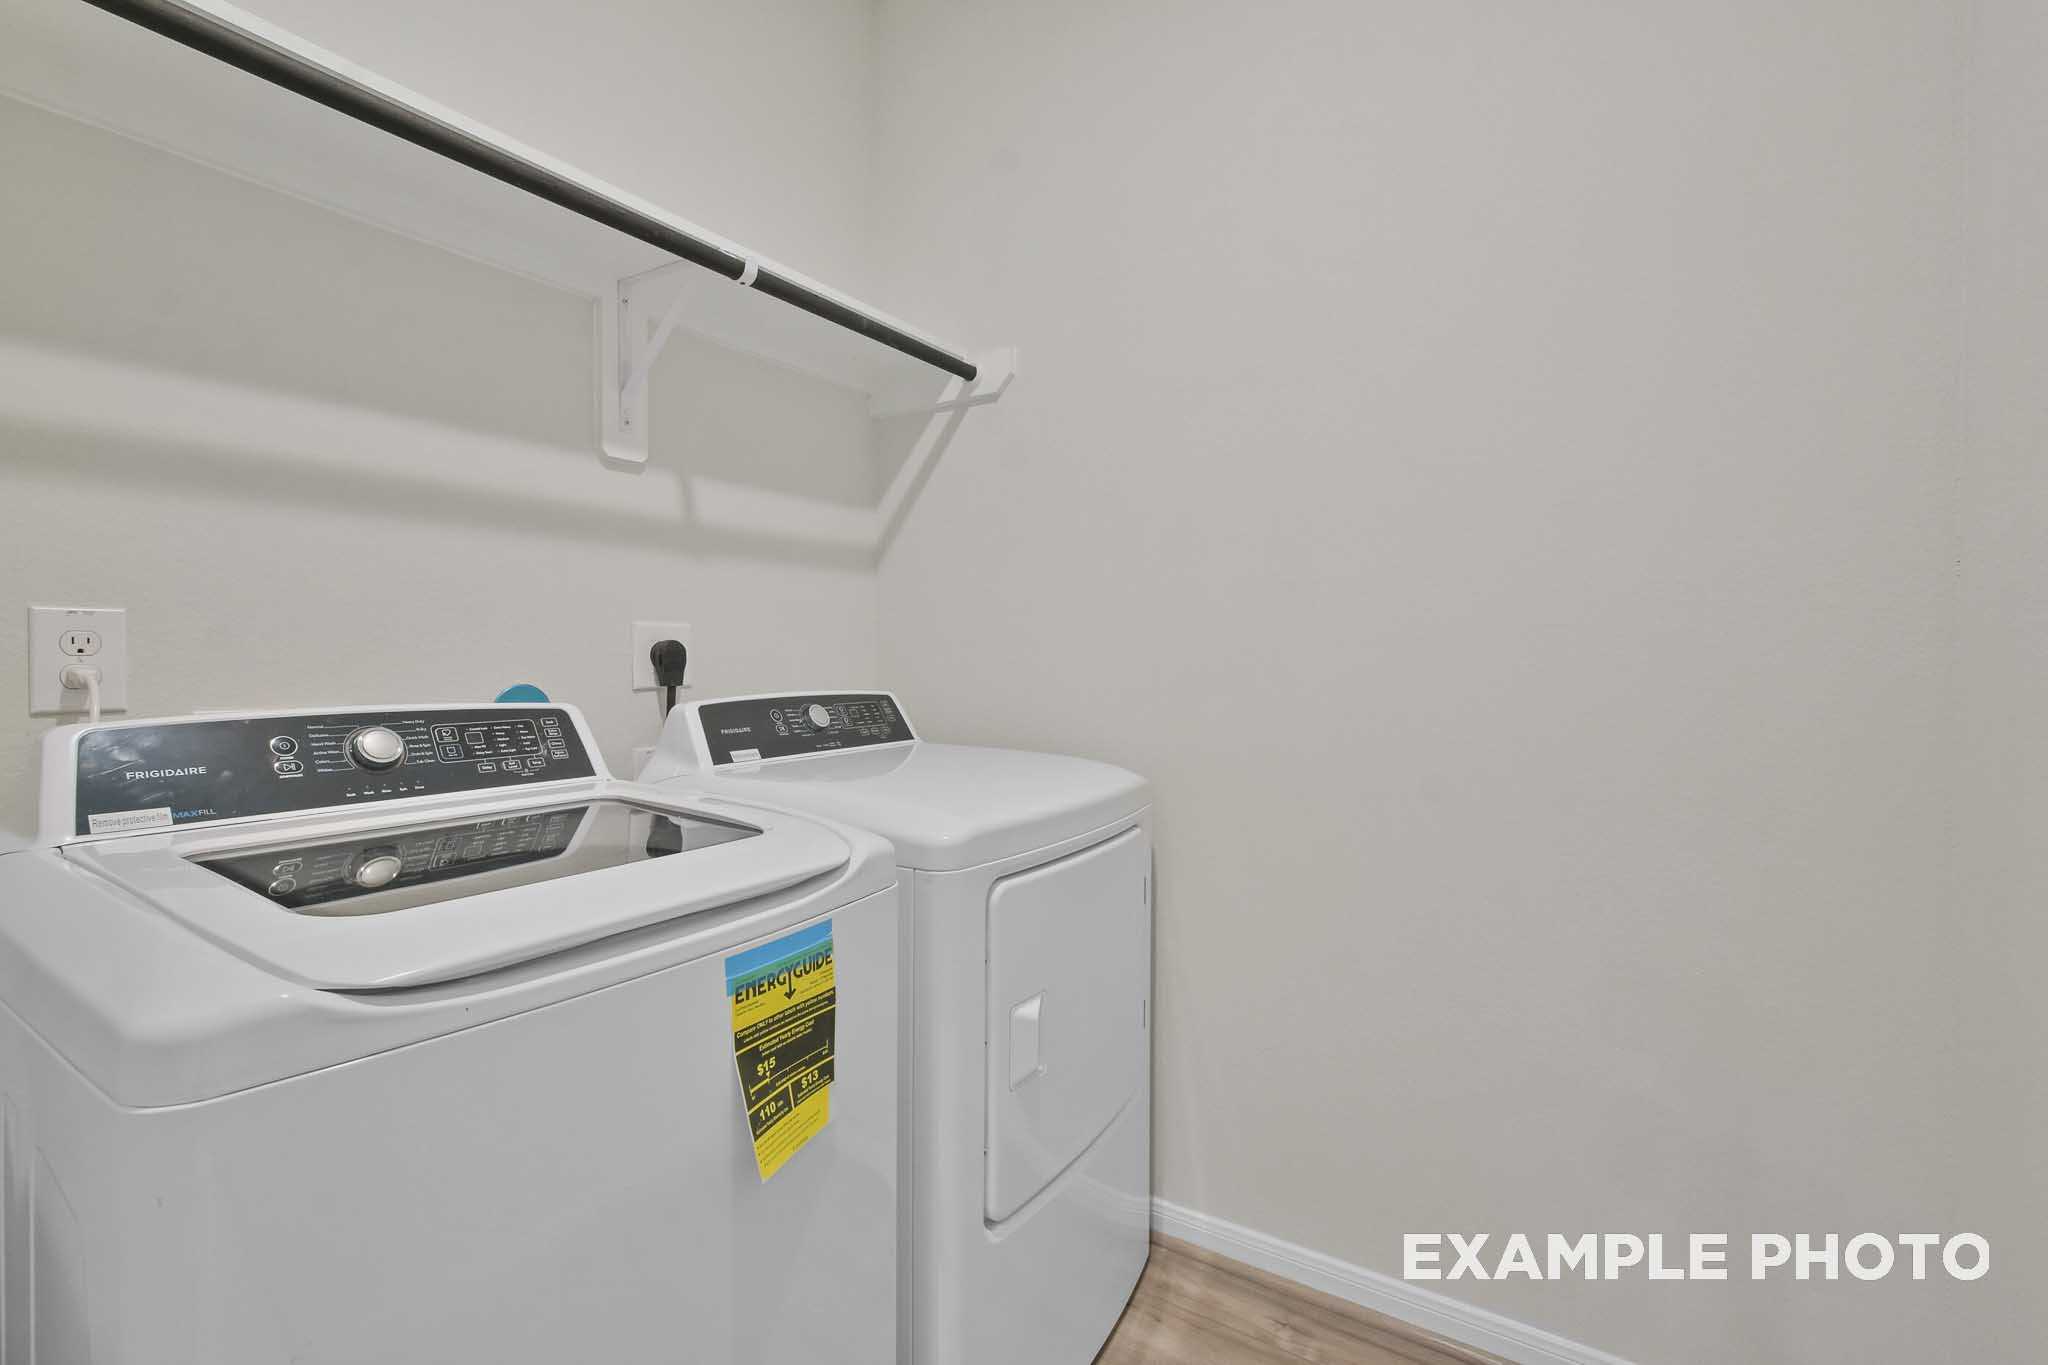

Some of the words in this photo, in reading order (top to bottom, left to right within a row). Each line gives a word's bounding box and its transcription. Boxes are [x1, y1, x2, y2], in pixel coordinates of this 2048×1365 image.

[126, 766, 208, 781] FRIGIDAIRE
[172, 808, 217, 819] MAXFILL
[756, 1056, 776, 1077] $15
[801, 1070, 819, 1089] $13
[759, 1101, 777, 1121] 110
